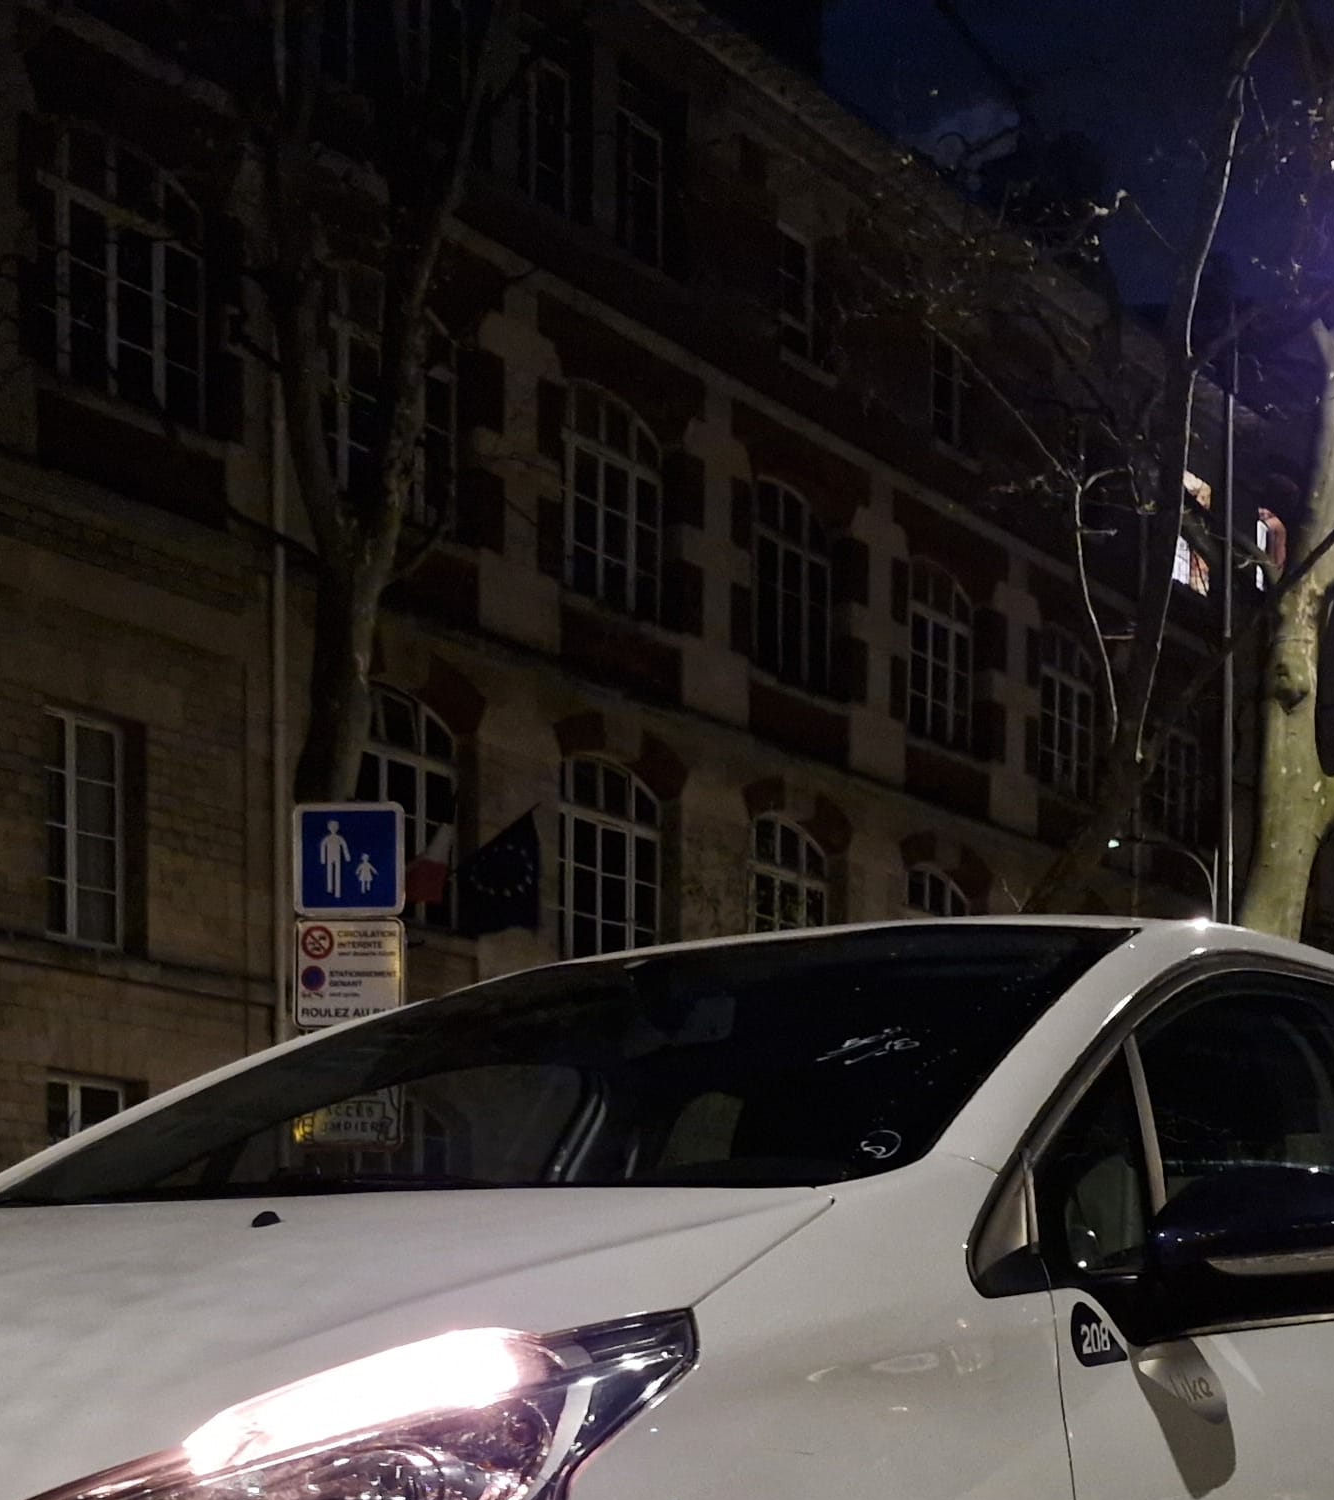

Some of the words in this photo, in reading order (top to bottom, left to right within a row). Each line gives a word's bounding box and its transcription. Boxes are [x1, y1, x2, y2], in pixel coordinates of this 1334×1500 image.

[301, 1008, 349, 1018] ROULEZ
[353, 1008, 370, 1017] AU
[1080, 1321, 1111, 1355] 208
